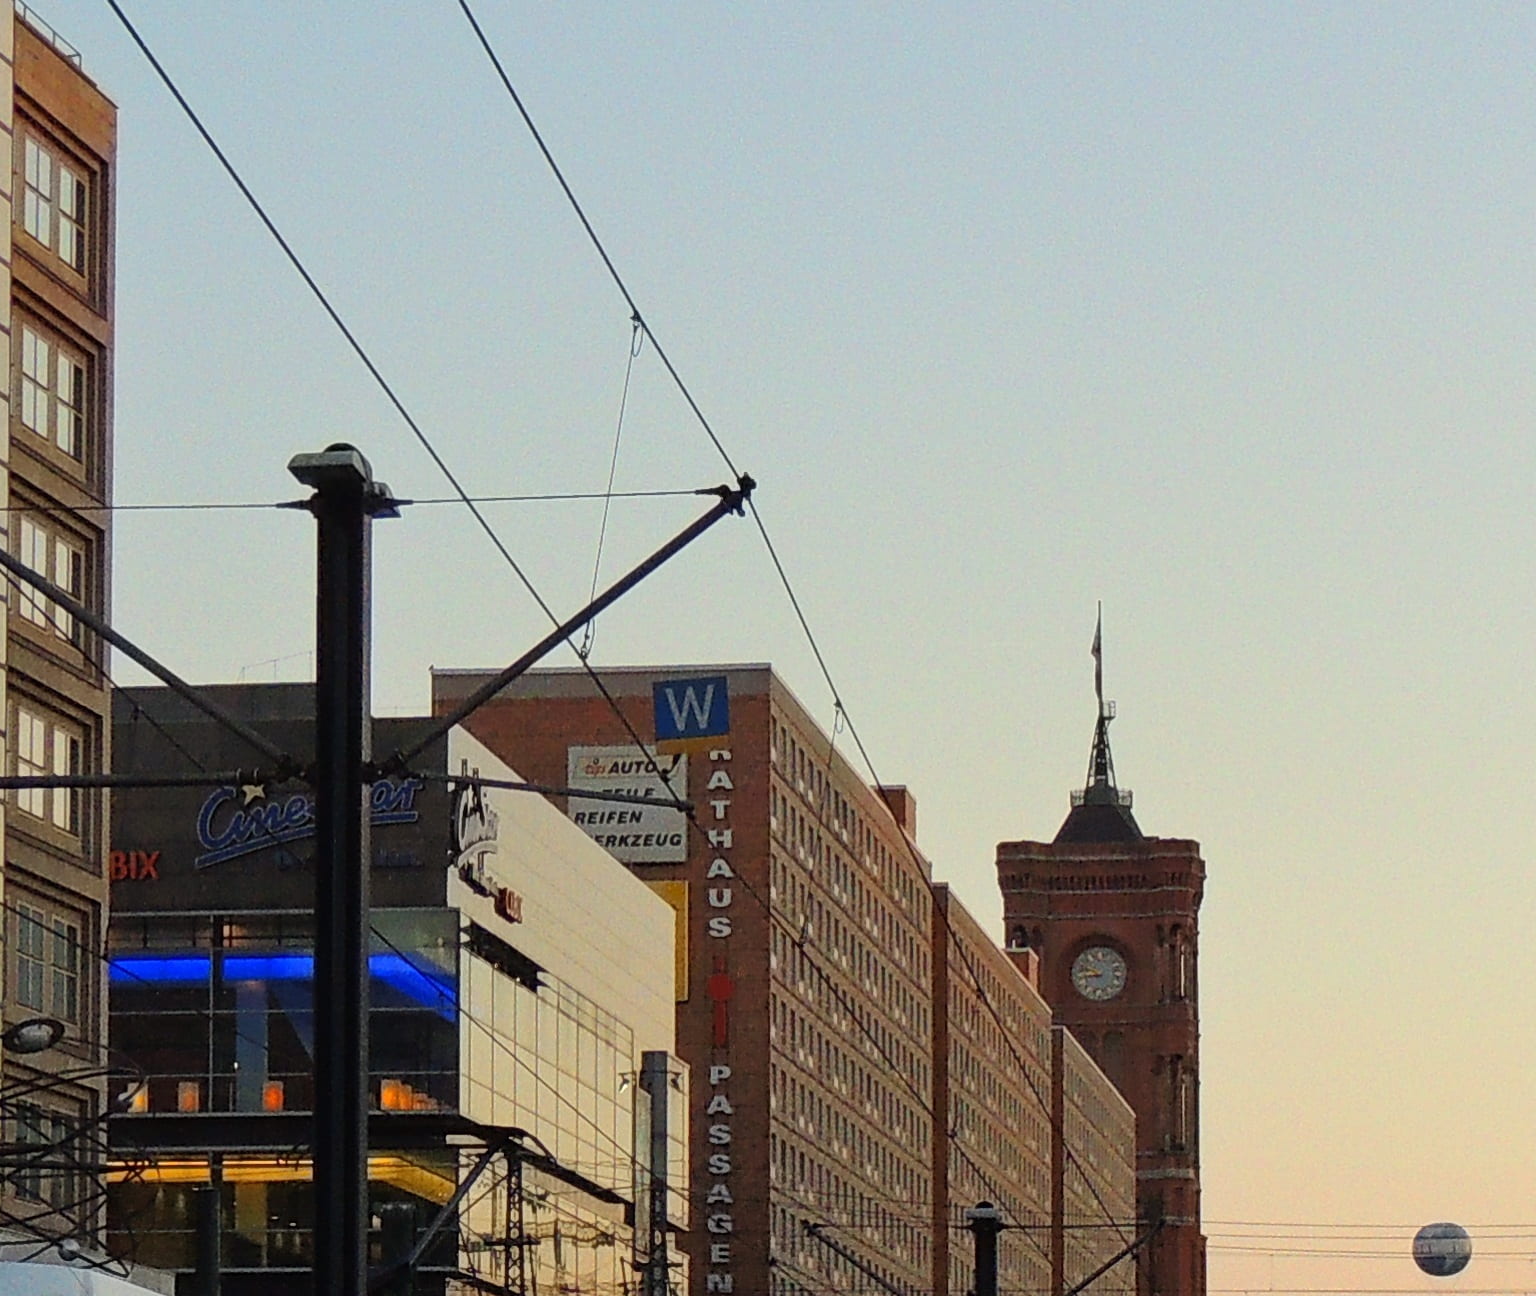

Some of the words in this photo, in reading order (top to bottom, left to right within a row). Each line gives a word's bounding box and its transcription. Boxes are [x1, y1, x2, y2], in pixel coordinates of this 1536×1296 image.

[665, 684, 714, 732] W
[608, 761, 657, 773] AUTO
[196, 779, 423, 851] Cinear
[575, 811, 643, 824] REIFEN
[590, 834, 682, 848] ERKZEUG
[706, 1066, 734, 1294] PASSAGEN
